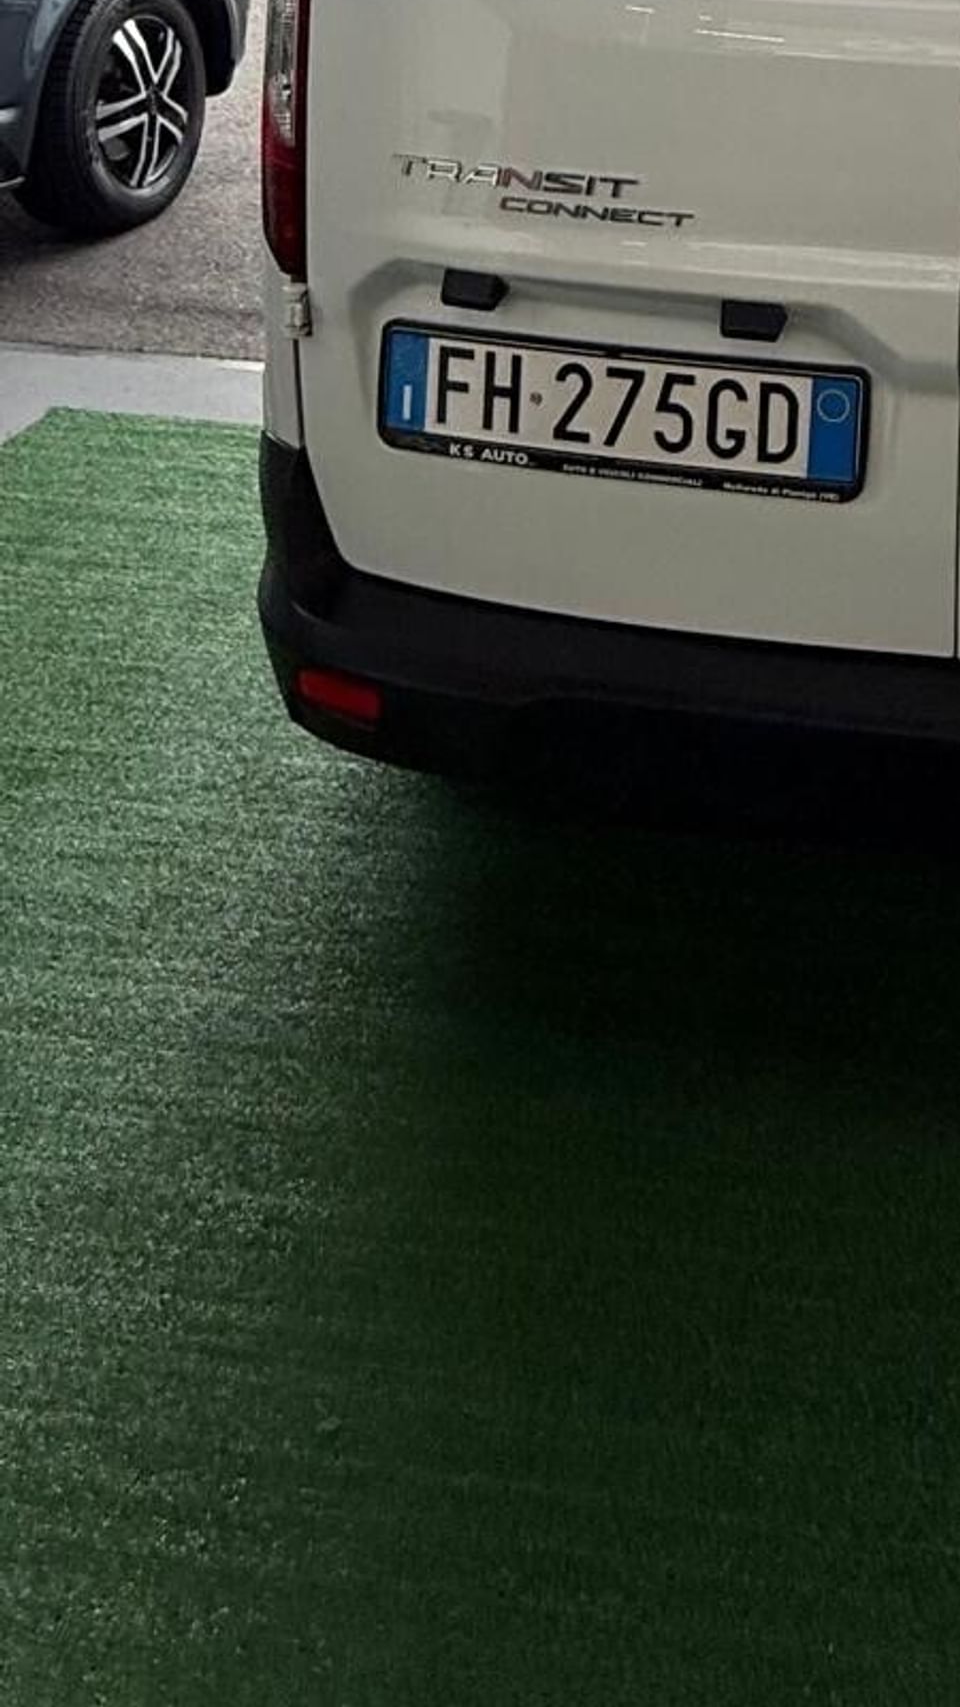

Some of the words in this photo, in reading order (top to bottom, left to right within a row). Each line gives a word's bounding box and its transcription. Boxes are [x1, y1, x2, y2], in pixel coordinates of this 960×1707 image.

[393, 153, 639, 199] TRANSIT
[500, 196, 695, 227] CONNECT
[436, 346, 522, 433] FH
[553, 362, 800, 464] 275GD
[450, 444, 474, 459] KS
[481, 448, 529, 466] AUTO
